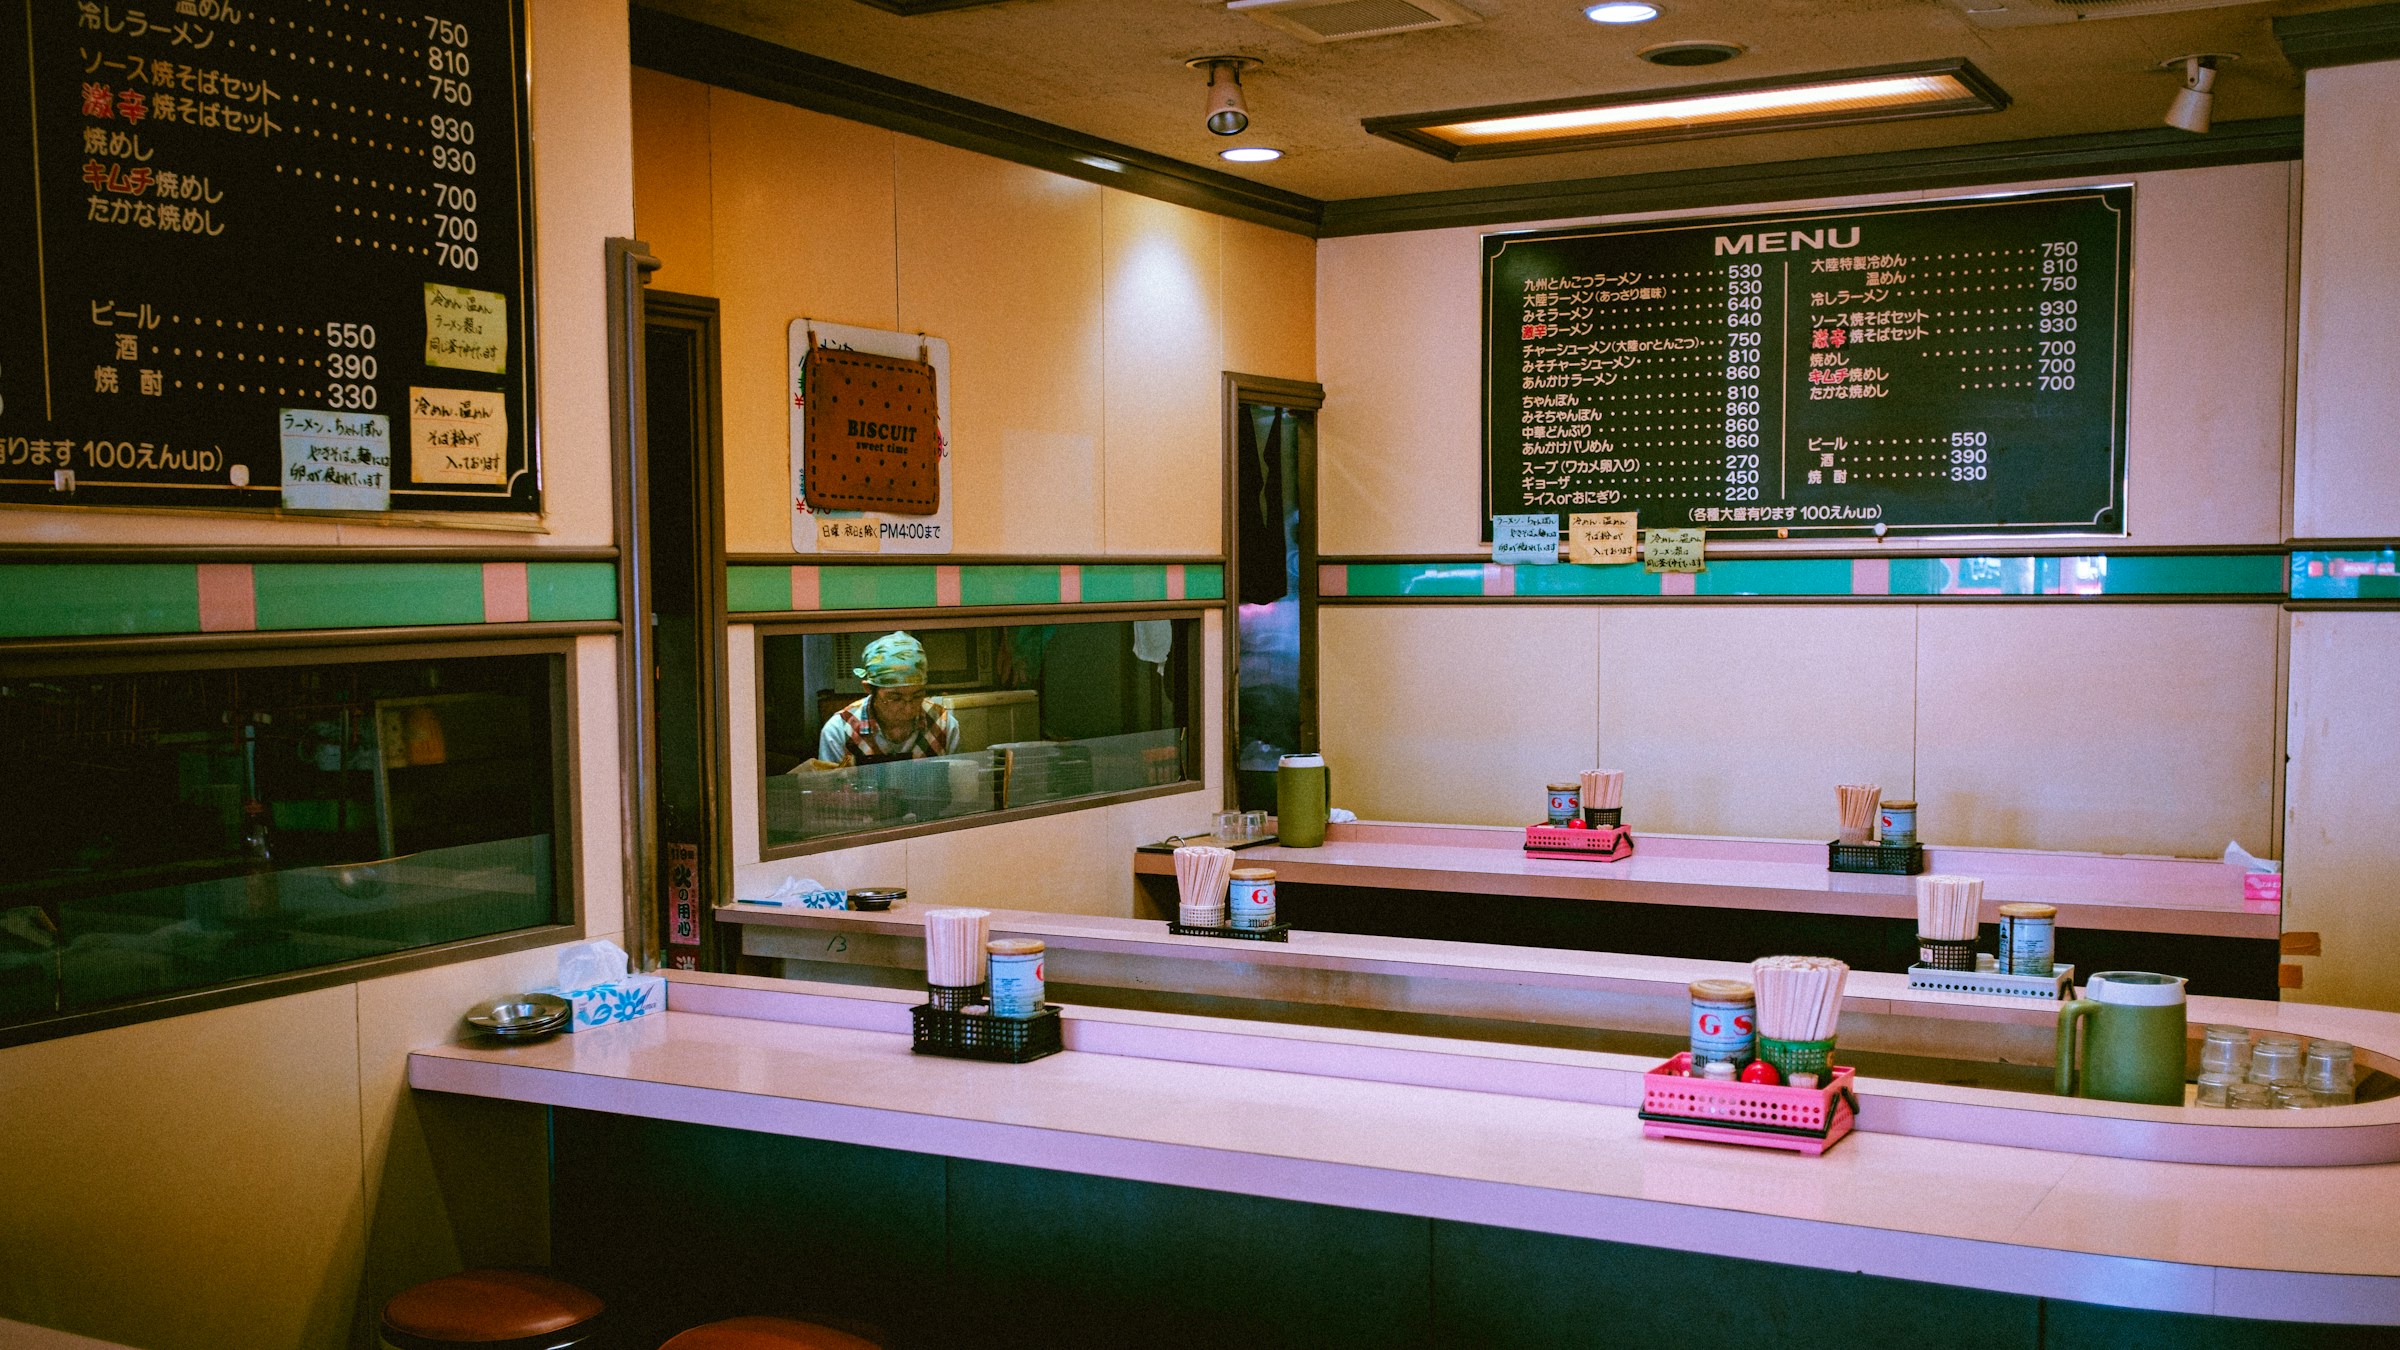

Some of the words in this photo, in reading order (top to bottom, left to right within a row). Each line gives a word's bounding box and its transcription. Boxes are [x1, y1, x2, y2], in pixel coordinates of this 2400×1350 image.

[423, 16, 468, 49] 750
[79, 1, 215, 49] 冷しラーメン
[428, 76, 473, 107] 750
[428, 46, 470, 76] 810
[80, 47, 282, 106] ソース焼そばセット
[430, 115, 474, 146] 930
[83, 127, 154, 162] 焼めし
[433, 183, 477, 213] 700
[431, 145, 476, 176] 930
[82, 160, 224, 205] キムチ焼めし
[434, 214, 478, 244] 700
[87, 196, 225, 237] たかな焼めし
[435, 242, 479, 272] 700
[1714, 226, 1861, 256] MENU
[1811, 254, 1907, 273] 大陸特製冷めん
[2042, 241, 2078, 257] 750
[1524, 272, 1642, 292] 九州とんこつラーメン
[1728, 264, 1762, 279] 530
[1866, 272, 1907, 286] 温めん
[2042, 258, 2078, 275] 810
[1728, 280, 1762, 295] 530
[1810, 289, 1889, 307] 冷しラーメン
[2041, 276, 2078, 292] 750
[1523, 306, 1594, 323] みそラーメン
[1727, 296, 1762, 311] 640
[1727, 312, 1762, 328] 640
[1811, 309, 1929, 328] ソース焼そばセット
[2040, 300, 2078, 316] 930
[90, 299, 161, 331] ビール
[327, 322, 376, 350] 550
[2039, 317, 2077, 333] 930
[1729, 332, 1761, 347] 750
[115, 333, 138, 362] 酒
[327, 354, 378, 381] 390
[1522, 355, 1636, 374] みそチャーシューメン
[1728, 349, 1761, 364] 810
[1810, 352, 1850, 367] 焼めし
[2039, 340, 2076, 356] 700
[1522, 373, 1617, 390] あんかけラーメン
[1726, 366, 1760, 380] 860
[1808, 366, 1889, 384] キムチ焼めし
[2039, 358, 2076, 374] 700
[327, 384, 377, 410] 330
[1522, 394, 1579, 409] ちゃんぽん
[1727, 385, 1759, 400] 810
[1810, 385, 1889, 400] たかな焼めし
[2038, 376, 2075, 391] 700
[1522, 409, 1602, 424] みそちゃんぽん
[1725, 401, 1760, 416] 860
[847, 419, 917, 443] BISCUIT
[1522, 424, 1592, 440] 中華どんぶり
[1725, 418, 1759, 433] 860
[1808, 437, 1847, 452] ビール
[1951, 432, 1988, 447] 550
[83, 440, 224, 472] 100えんup)
[856, 441, 884, 452] sweet
[887, 443, 909, 454] time
[1522, 440, 1613, 456] あんかけバリめん
[1725, 434, 1759, 449] 860
[1725, 455, 1759, 470] 270
[1820, 453, 1834, 468] 酒
[1950, 449, 1988, 464] 390
[1522, 475, 1571, 490] ギョーザ
[1725, 470, 1759, 485] 450
[1950, 466, 1988, 481] 330
[1523, 490, 1621, 506] ライスorおにぎり
[1725, 487, 1759, 501] 220
[674, 863, 691, 937] 火の用心
[1698, 1013, 1721, 1036] G
